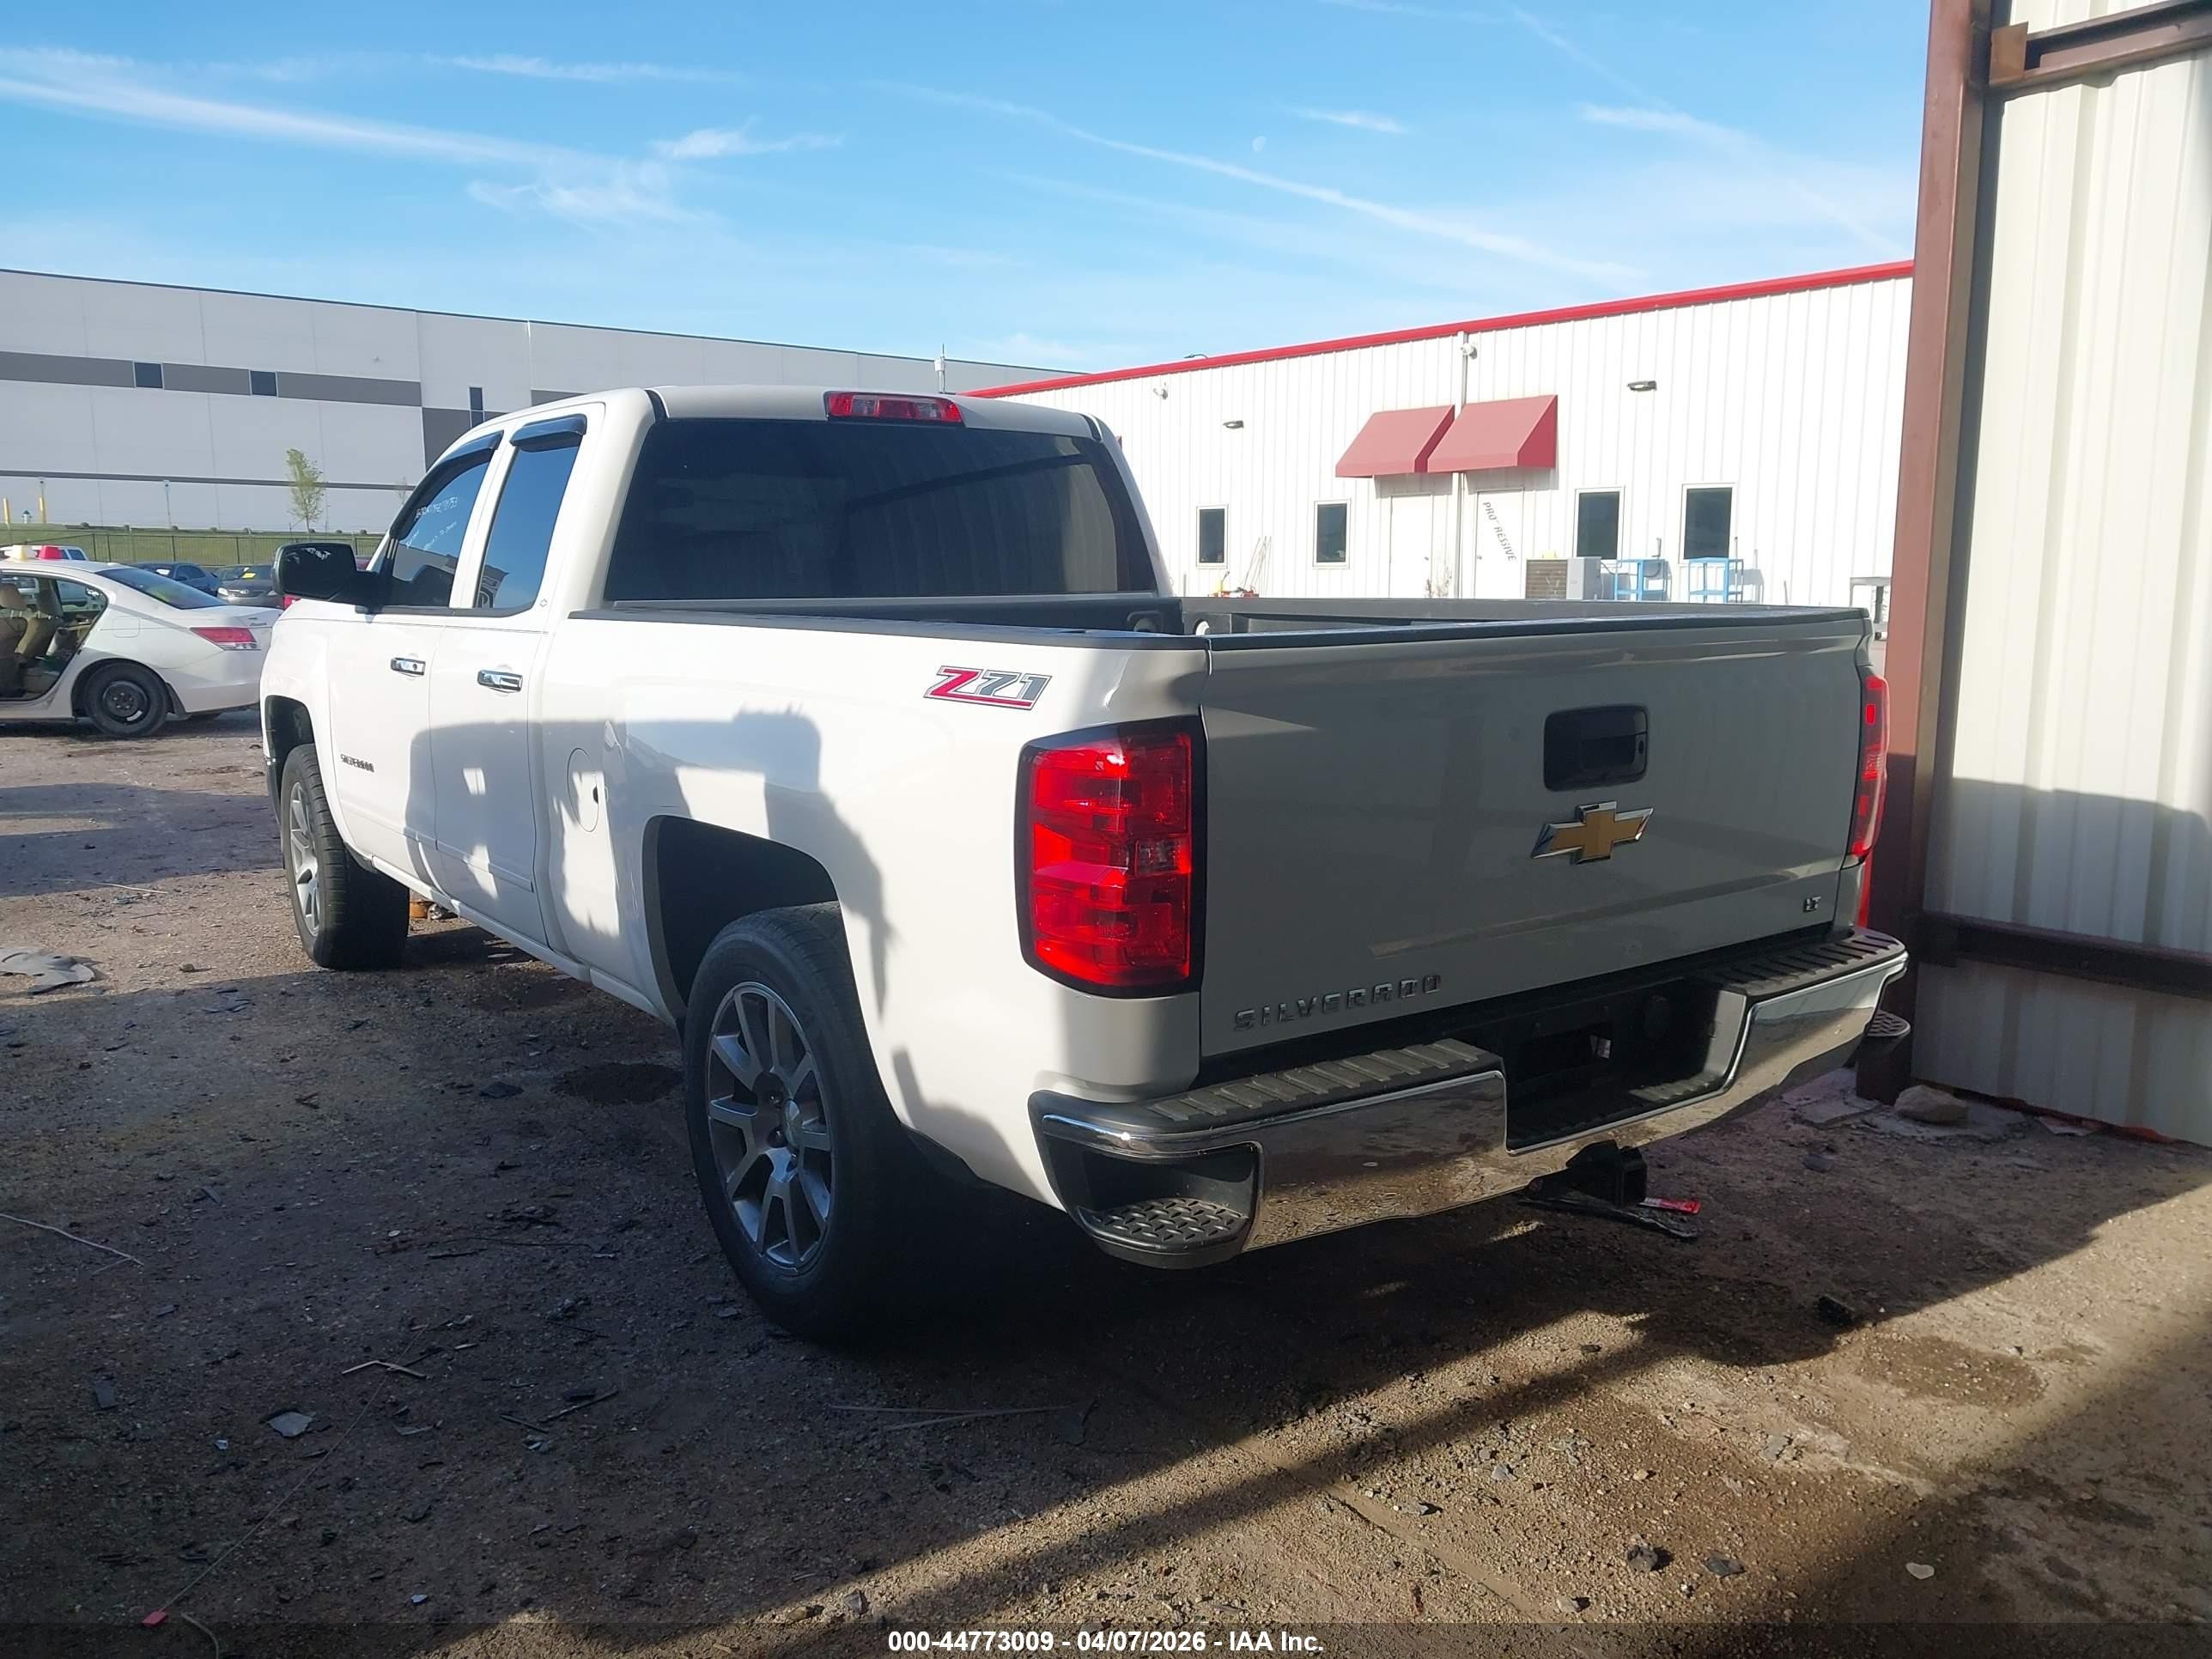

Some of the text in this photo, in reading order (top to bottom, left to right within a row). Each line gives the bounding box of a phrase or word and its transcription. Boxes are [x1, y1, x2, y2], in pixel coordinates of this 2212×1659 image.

[1482, 501, 1517, 562] PRORESSIVE
[923, 665, 1053, 710] Z71
[1803, 896, 1821, 913] LT
[1233, 975, 1442, 1031] SILVERADO
